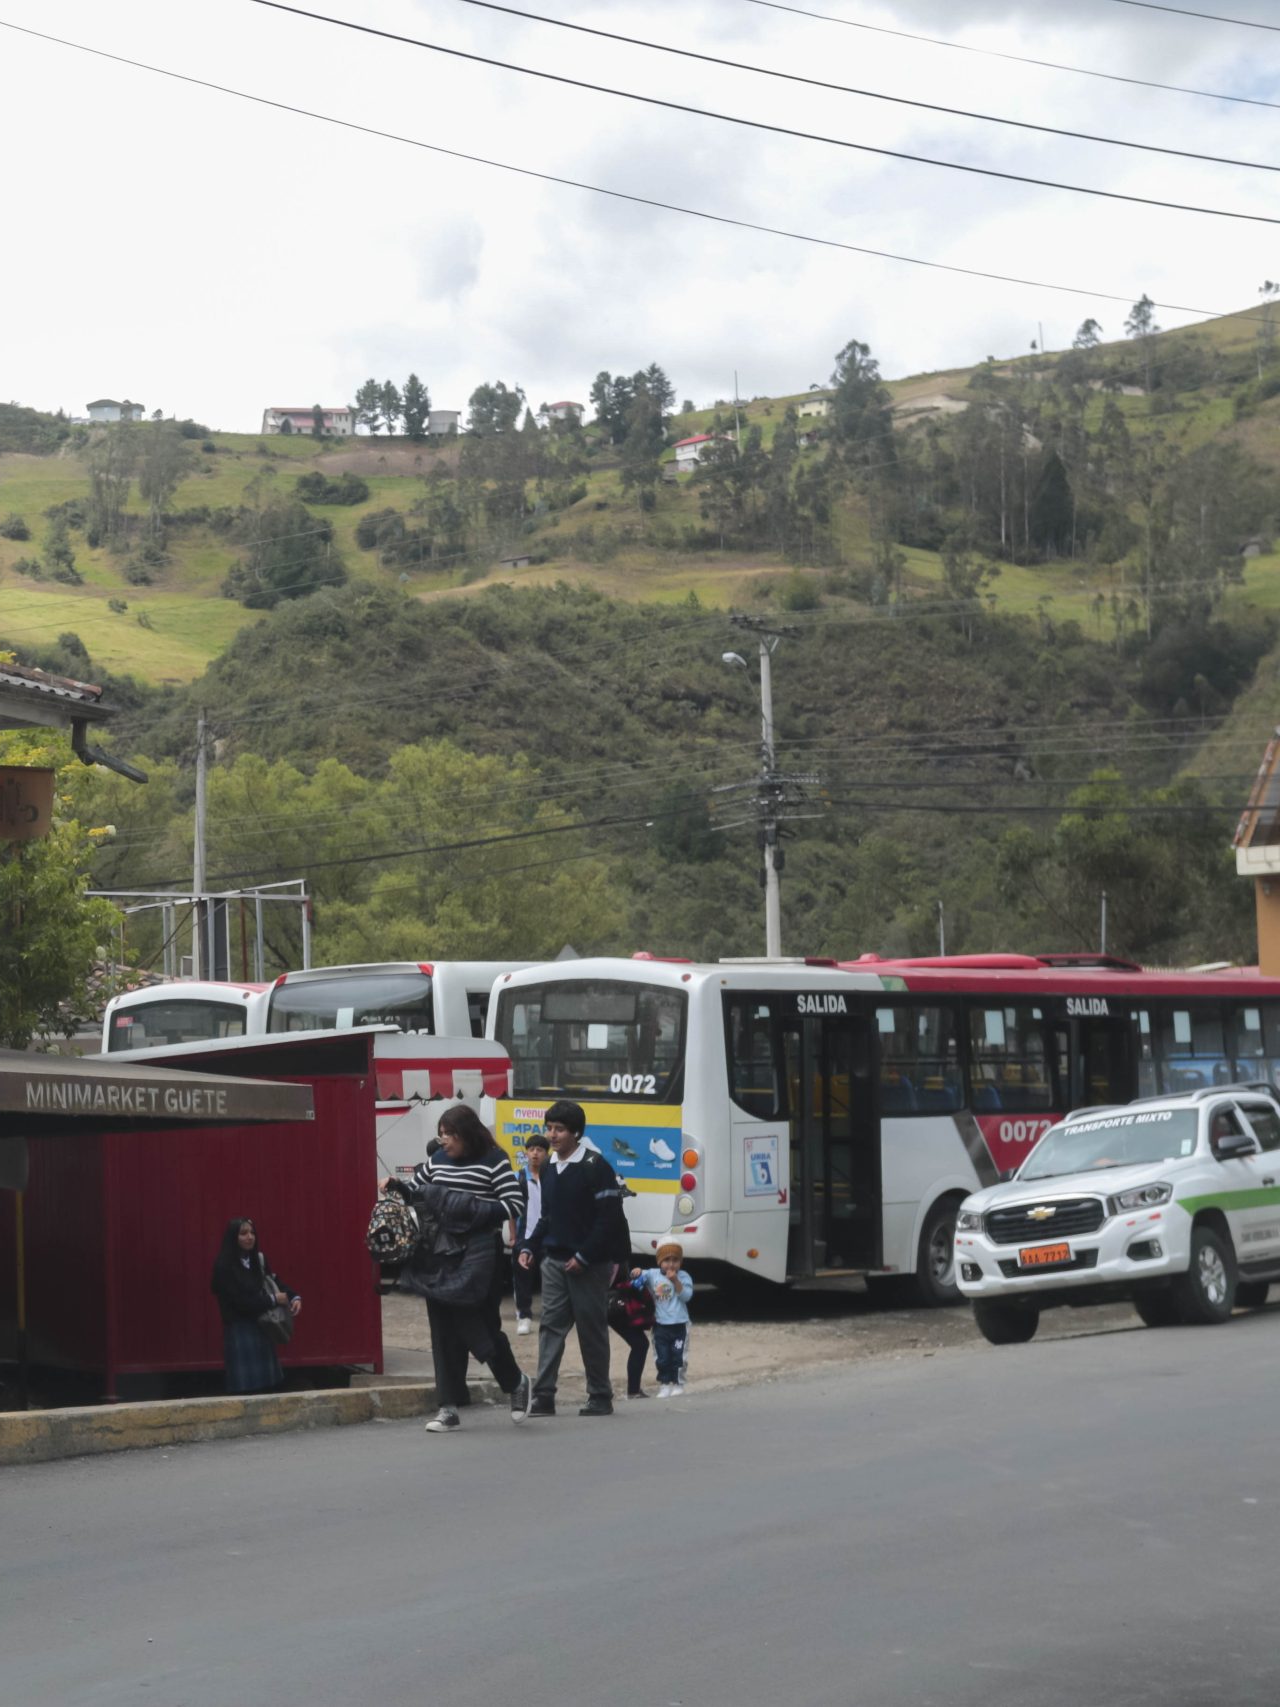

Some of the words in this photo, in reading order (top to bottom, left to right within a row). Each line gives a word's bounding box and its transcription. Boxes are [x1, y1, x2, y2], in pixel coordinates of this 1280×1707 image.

[796, 995, 847, 1013] SALIDA
[1066, 998, 1109, 1016] SALIDA
[610, 1073, 656, 1095] 0072
[25, 1082, 159, 1112] MINIMARKET
[164, 1088, 227, 1114] GUETE
[1063, 1117, 1133, 1136] TRANSPORTE
[1135, 1111, 1173, 1125] MIXTO
